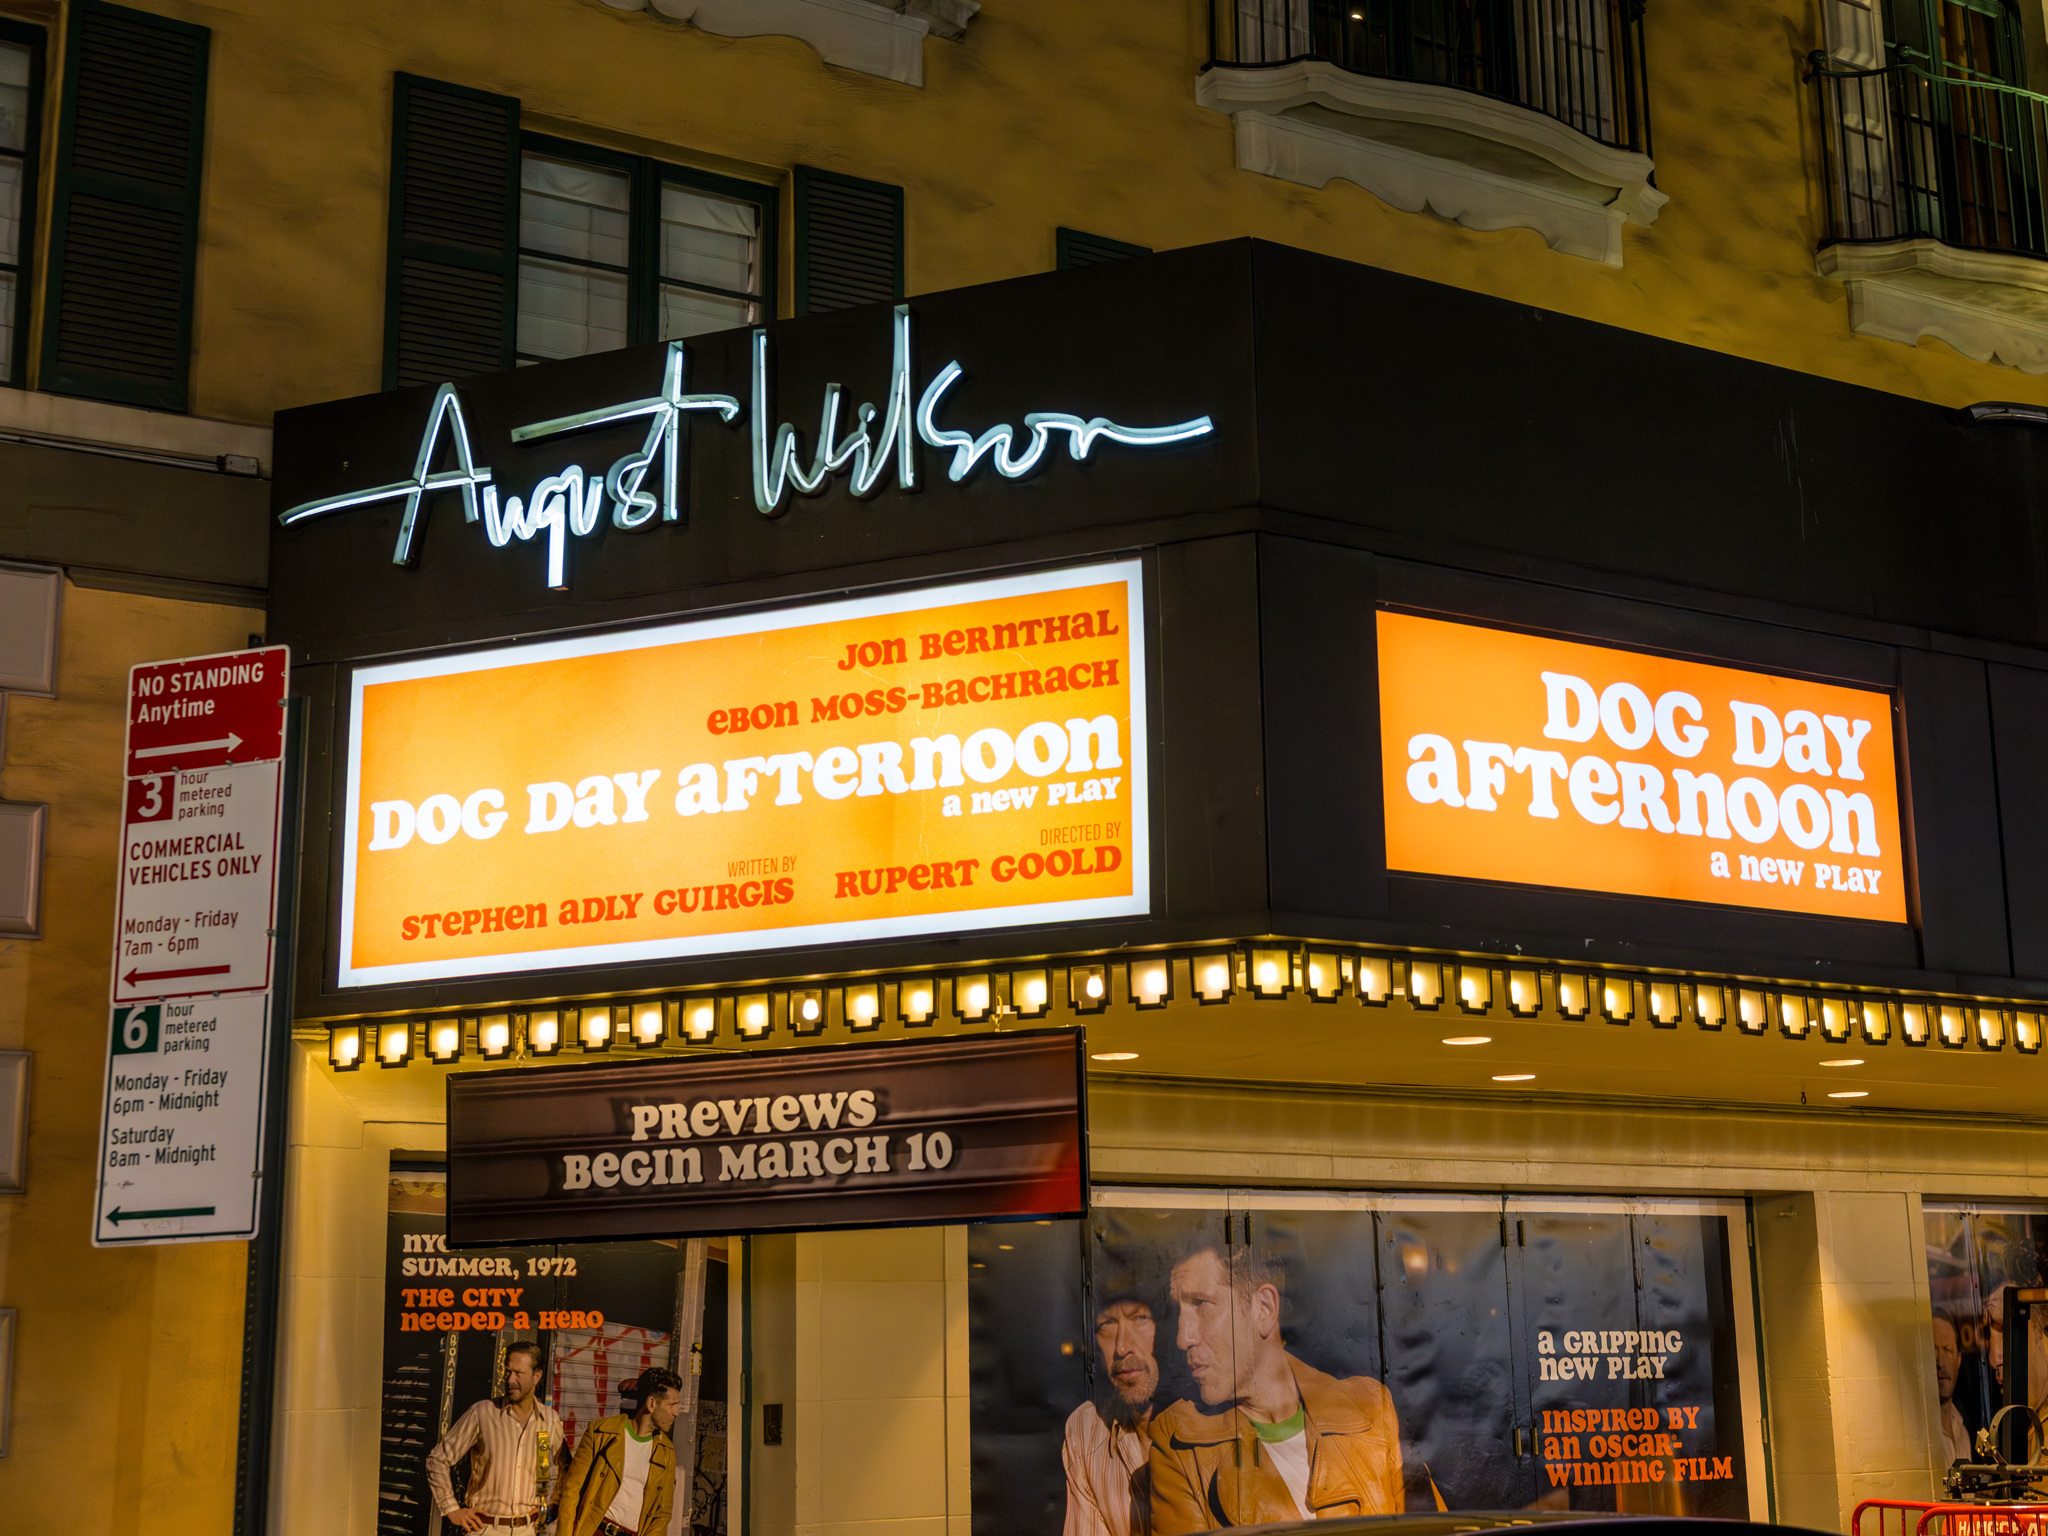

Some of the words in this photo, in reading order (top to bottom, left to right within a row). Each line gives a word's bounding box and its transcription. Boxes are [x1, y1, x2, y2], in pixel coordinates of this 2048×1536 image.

[278, 341, 740, 590] August
[752, 304, 1211, 517] Wilson
[138, 676, 165, 697] NO
[170, 662, 264, 693] STANDING
[138, 698, 216, 725] Anytime
[1541, 671, 1710, 758] DOG
[180, 772, 209, 786] hour
[138, 777, 163, 818] 3
[179, 784, 232, 803] metered
[178, 802, 225, 821] parking
[368, 788, 509, 851] DOG
[1040, 823, 1101, 846] DIRECTED
[1105, 821, 1121, 840] BY
[130, 832, 245, 861] COMMERCIAL
[129, 860, 212, 886] VEHICLES
[217, 854, 262, 877] ONLY
[727, 857, 778, 878] WRITTEN
[782, 855, 797, 874] BY
[991, 844, 1122, 883] GOOLD
[653, 876, 794, 916] GUIRGIS
[125, 915, 180, 935] Monday
[195, 910, 239, 929] Friday
[125, 940, 153, 956] 7am
[167, 936, 199, 954] 6pm
[166, 1003, 195, 1018] hour
[122, 1006, 149, 1049] 6
[165, 1017, 217, 1035] metered
[164, 1036, 210, 1055] parking
[114, 1072, 169, 1092] Monday
[184, 1068, 228, 1088] Friday
[113, 1097, 144, 1117] 6pm
[158, 1091, 220, 1112] Midnight
[111, 1126, 175, 1145] Saturday
[109, 1151, 140, 1168] 8am
[155, 1144, 216, 1166] Midnight
[906, 1131, 953, 1171] 10
[527, 1257, 577, 1277] 1972
[462, 1287, 524, 1307] CITY
[1666, 1406, 1700, 1430] BY
[1673, 1456, 1734, 1482] FILM
